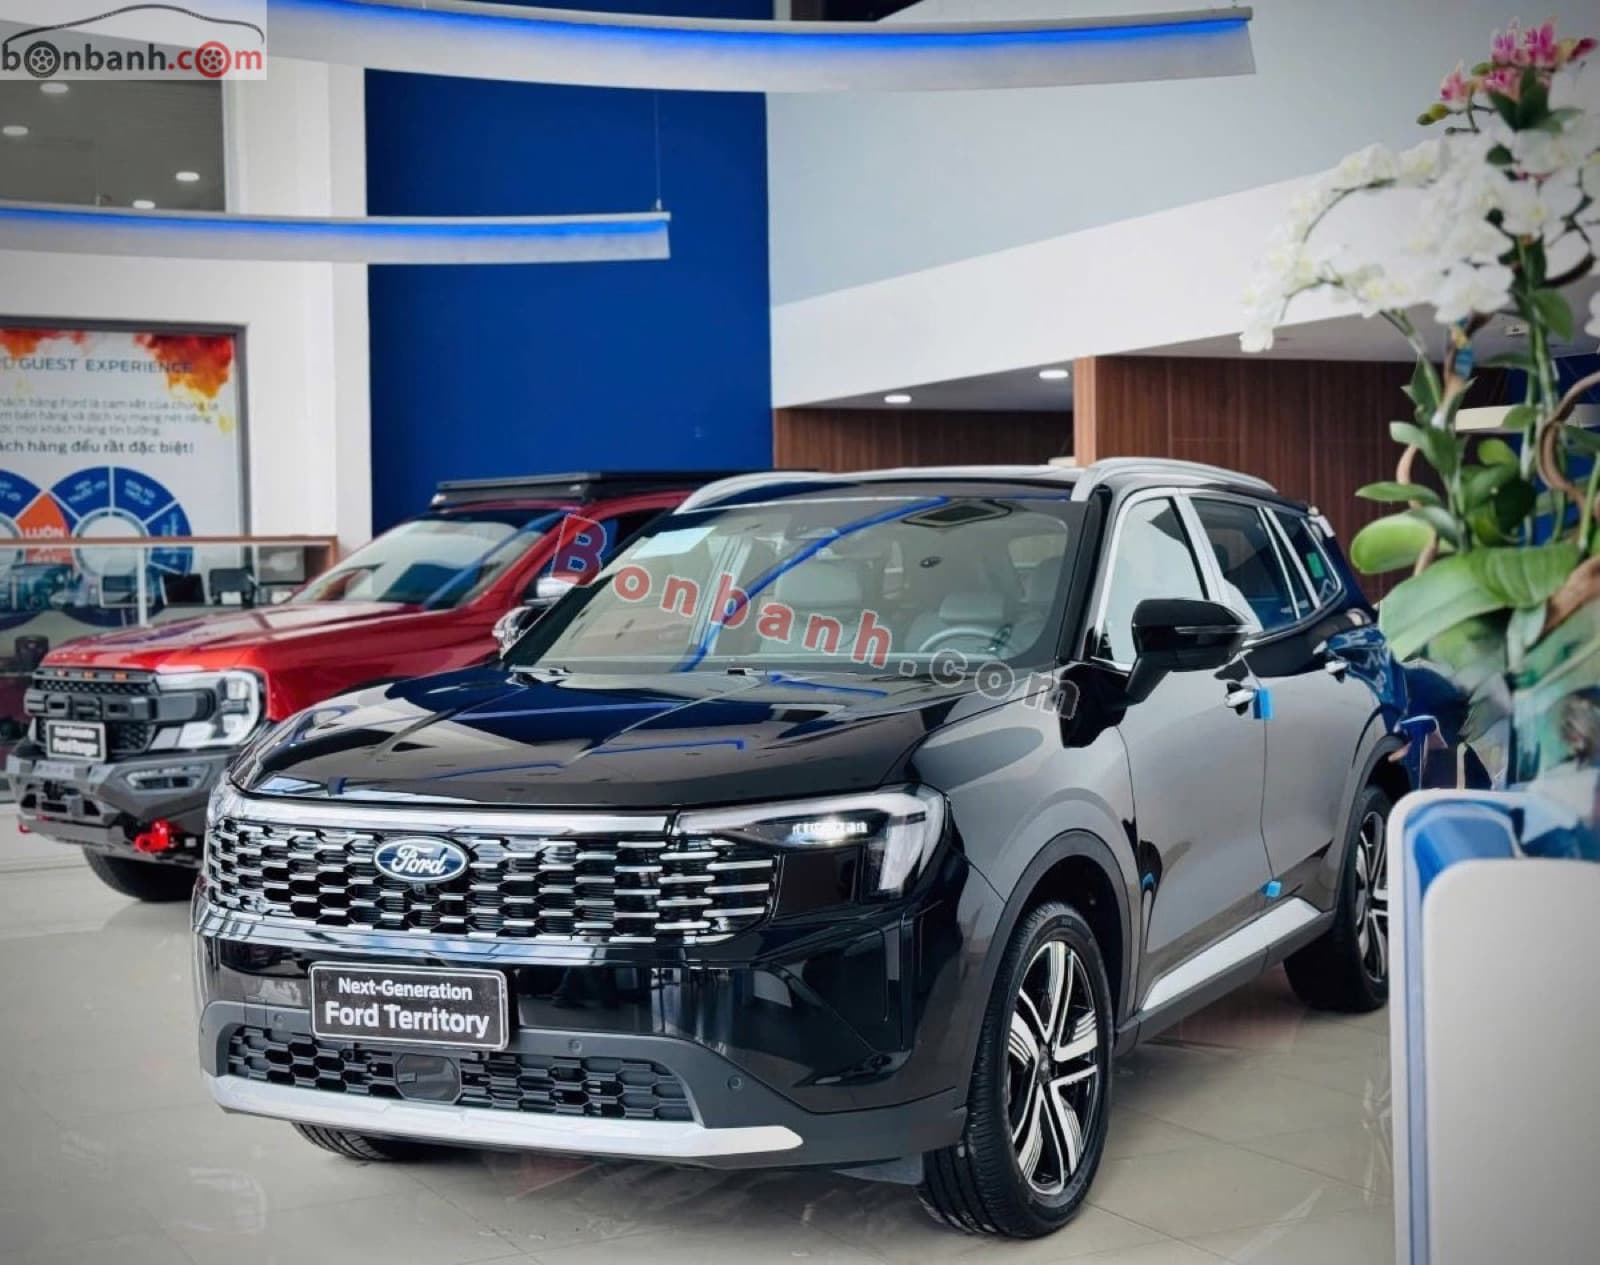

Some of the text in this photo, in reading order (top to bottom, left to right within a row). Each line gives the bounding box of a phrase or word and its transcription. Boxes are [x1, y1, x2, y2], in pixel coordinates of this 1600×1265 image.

[19, 357, 77, 371] GUEST
[85, 359, 193, 374] EXPERIENCE
[28, 440, 68, 455] hàng
[392, 842, 449, 875] Ford
[337, 976, 473, 1001] Next-Generation
[324, 1001, 490, 1039] Ford Territory
